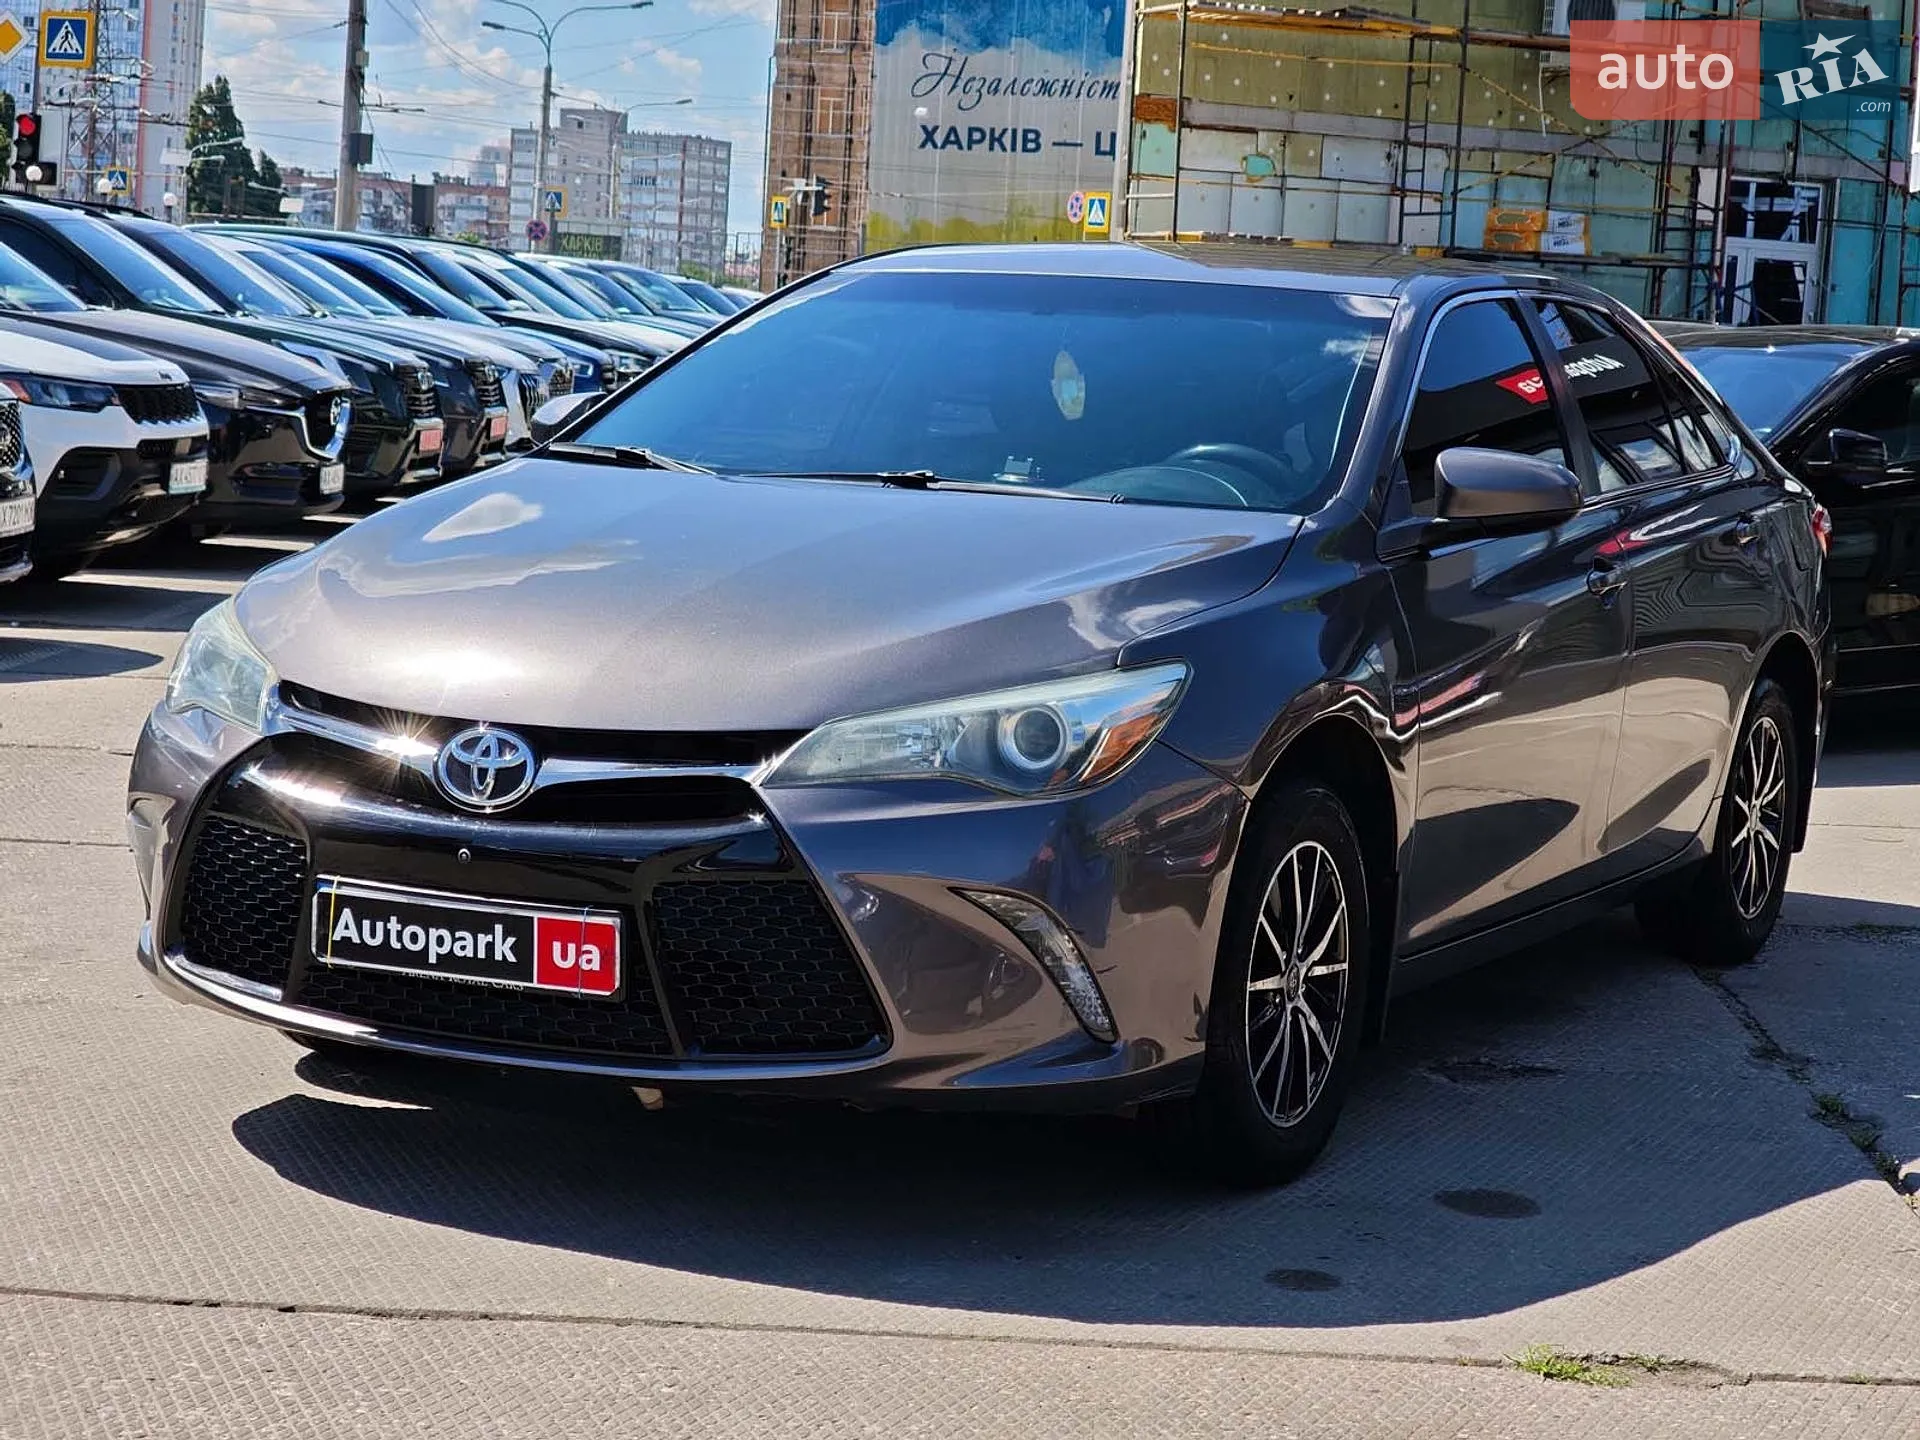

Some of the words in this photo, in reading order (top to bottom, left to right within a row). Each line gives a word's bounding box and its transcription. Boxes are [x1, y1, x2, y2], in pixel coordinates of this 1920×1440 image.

[918, 124, 1042, 154] ХАРКІВ
[333, 907, 518, 964] Autopark
[552, 940, 601, 971] ua
